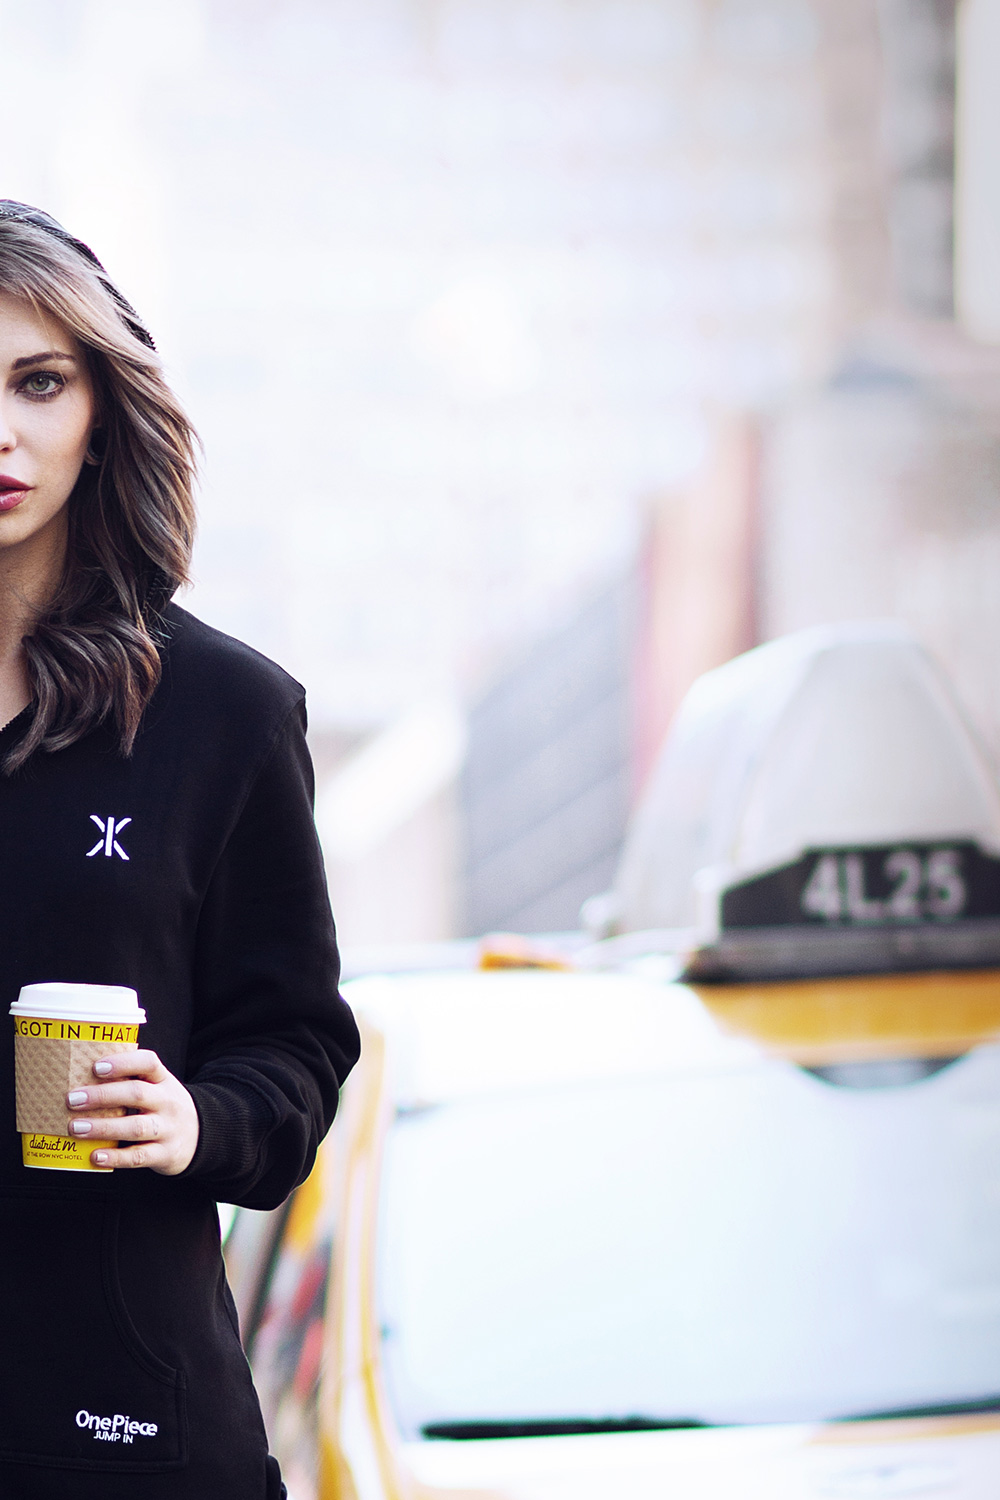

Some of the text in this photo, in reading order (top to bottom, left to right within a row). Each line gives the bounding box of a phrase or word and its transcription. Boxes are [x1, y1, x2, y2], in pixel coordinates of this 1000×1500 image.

[802, 851, 966, 919] 4L25
[20, 1021, 53, 1037] GOT
[60, 1023, 81, 1039] IN
[89, 1025, 132, 1042] THAT
[29, 1134, 61, 1151] district
[75, 1409, 158, 1436] OnePiece
[93, 1430, 134, 1444] JUMP IN
